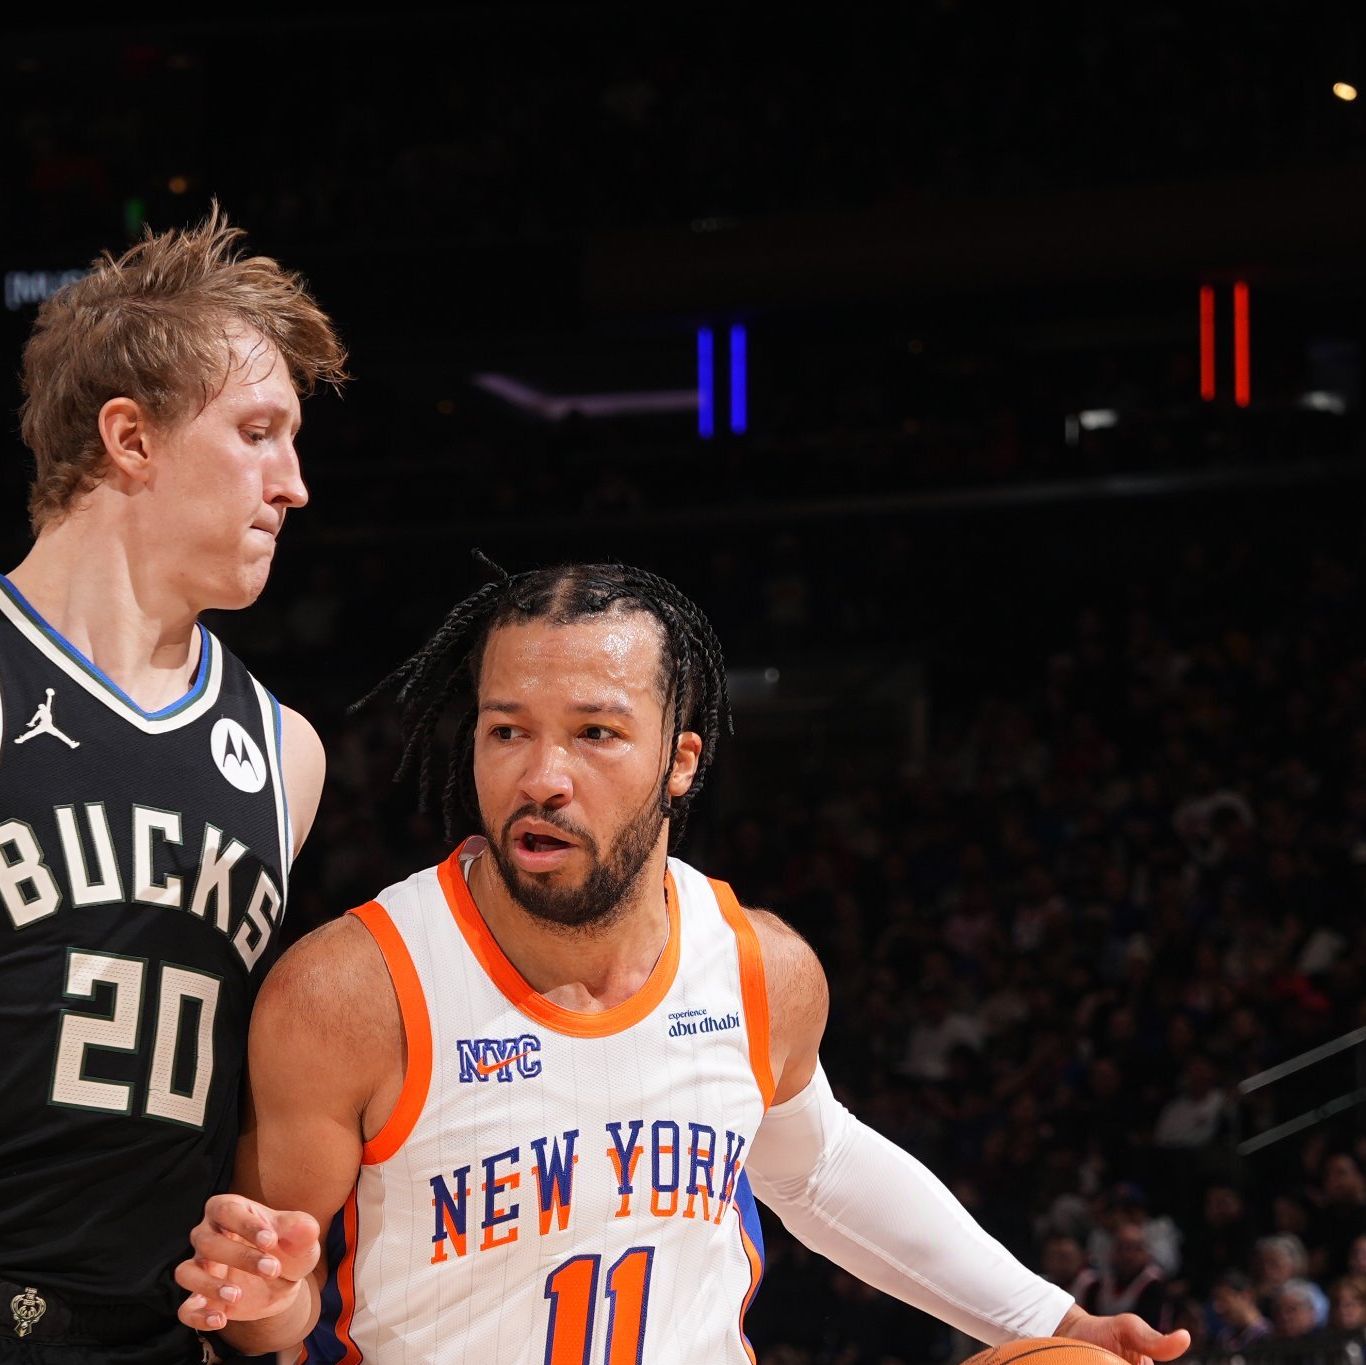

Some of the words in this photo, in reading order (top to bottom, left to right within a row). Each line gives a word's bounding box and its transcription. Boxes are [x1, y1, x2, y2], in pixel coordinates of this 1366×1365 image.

[47, 946, 224, 1132] 20
[668, 1009, 707, 1021] experience
[669, 1021, 697, 1037] abu
[456, 1033, 542, 1083] NYC
[430, 1129, 579, 1264] NEW
[606, 1120, 745, 1225] YORK
